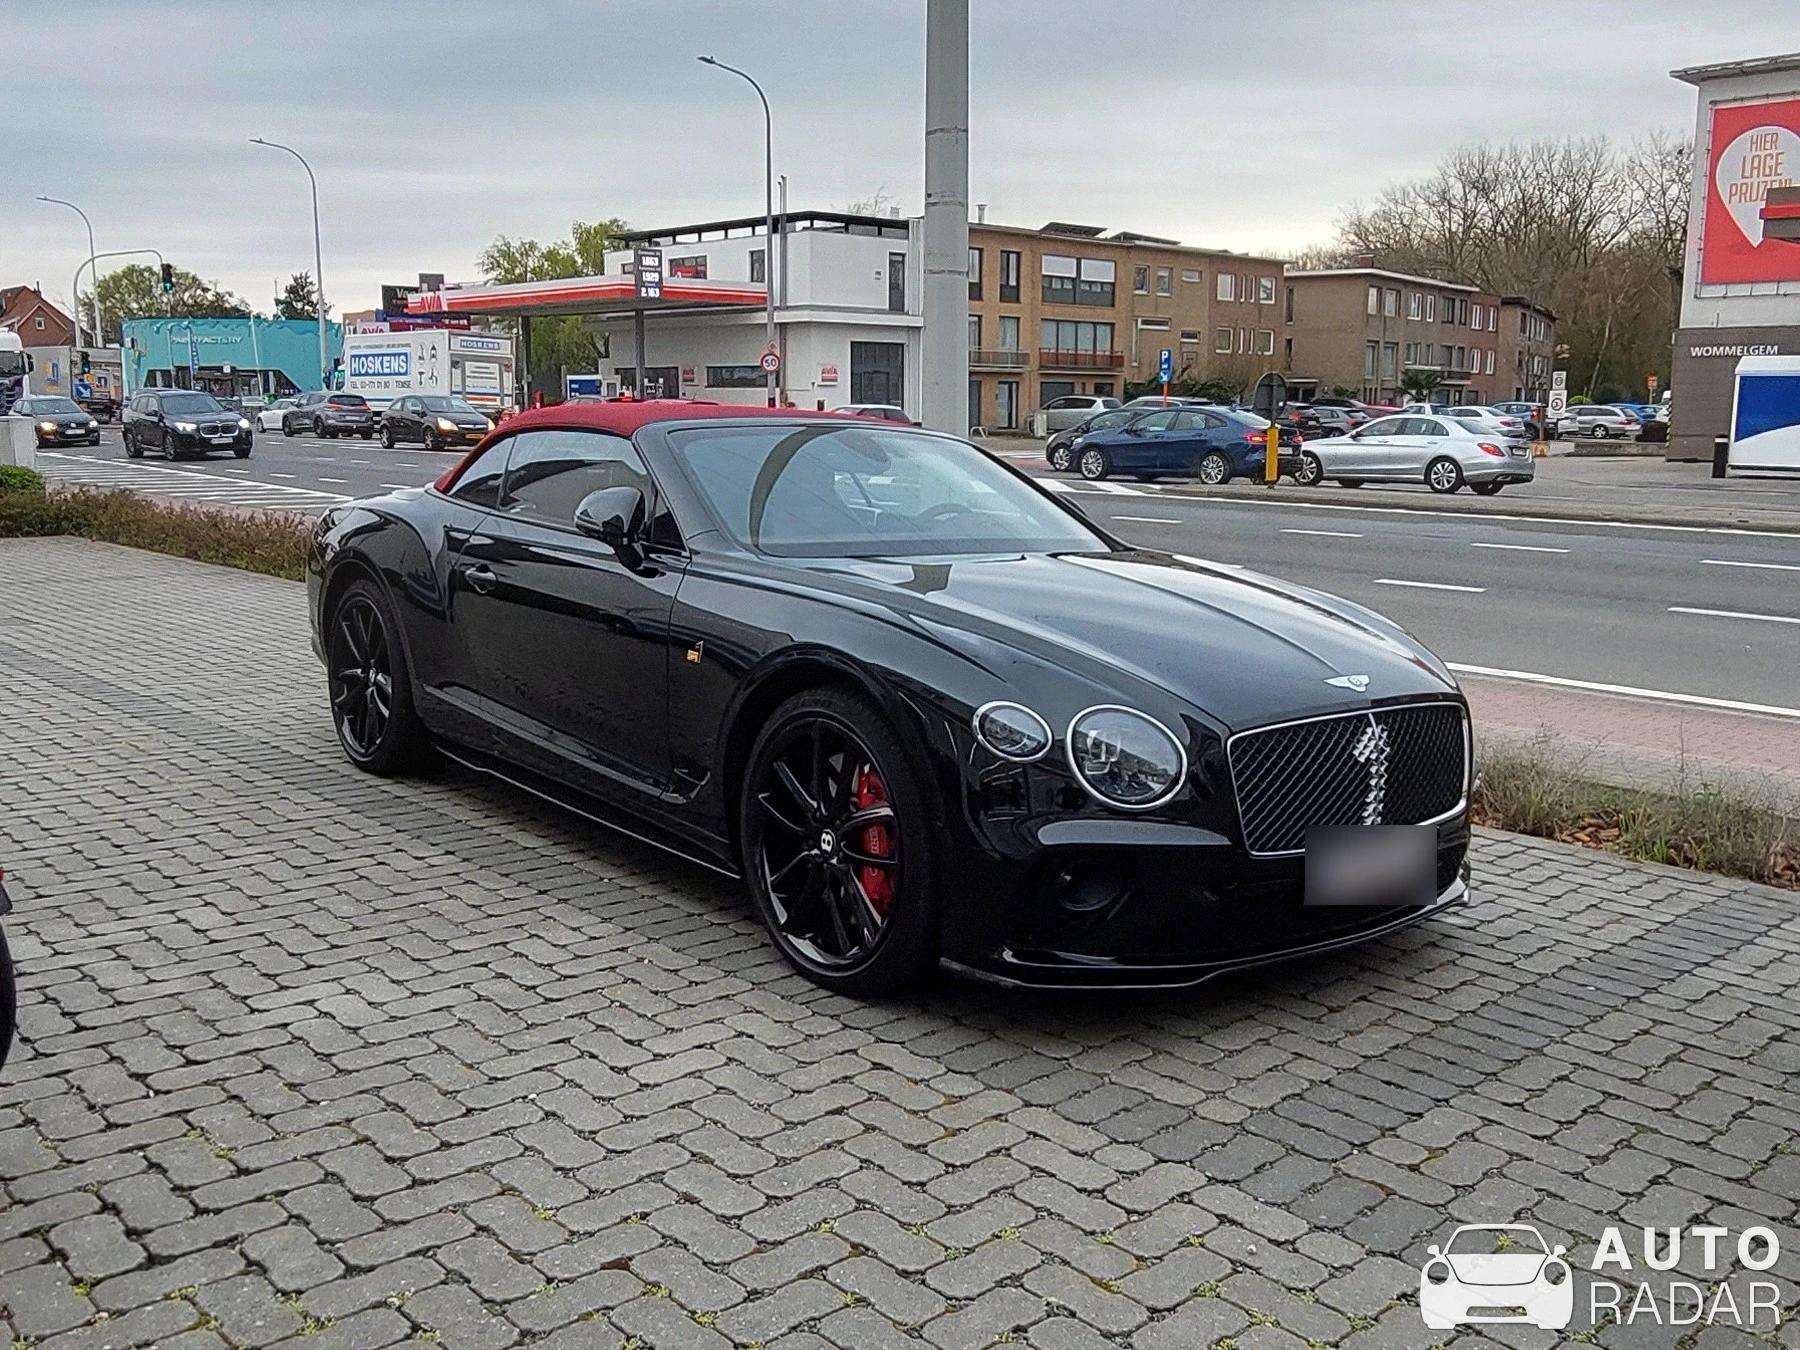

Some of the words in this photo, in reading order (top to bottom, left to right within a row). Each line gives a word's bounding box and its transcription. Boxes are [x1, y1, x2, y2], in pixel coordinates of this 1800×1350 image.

[1750, 133, 1778, 152] HIER
[1741, 152, 1784, 179] LAGE
[460, 341, 499, 349] HOSKENS
[1689, 345, 1778, 357] WOMMELGEM
[764, 358, 777, 368] 50
[1161, 351, 1169, 363] P
[351, 355, 407, 375] HOSKENS
